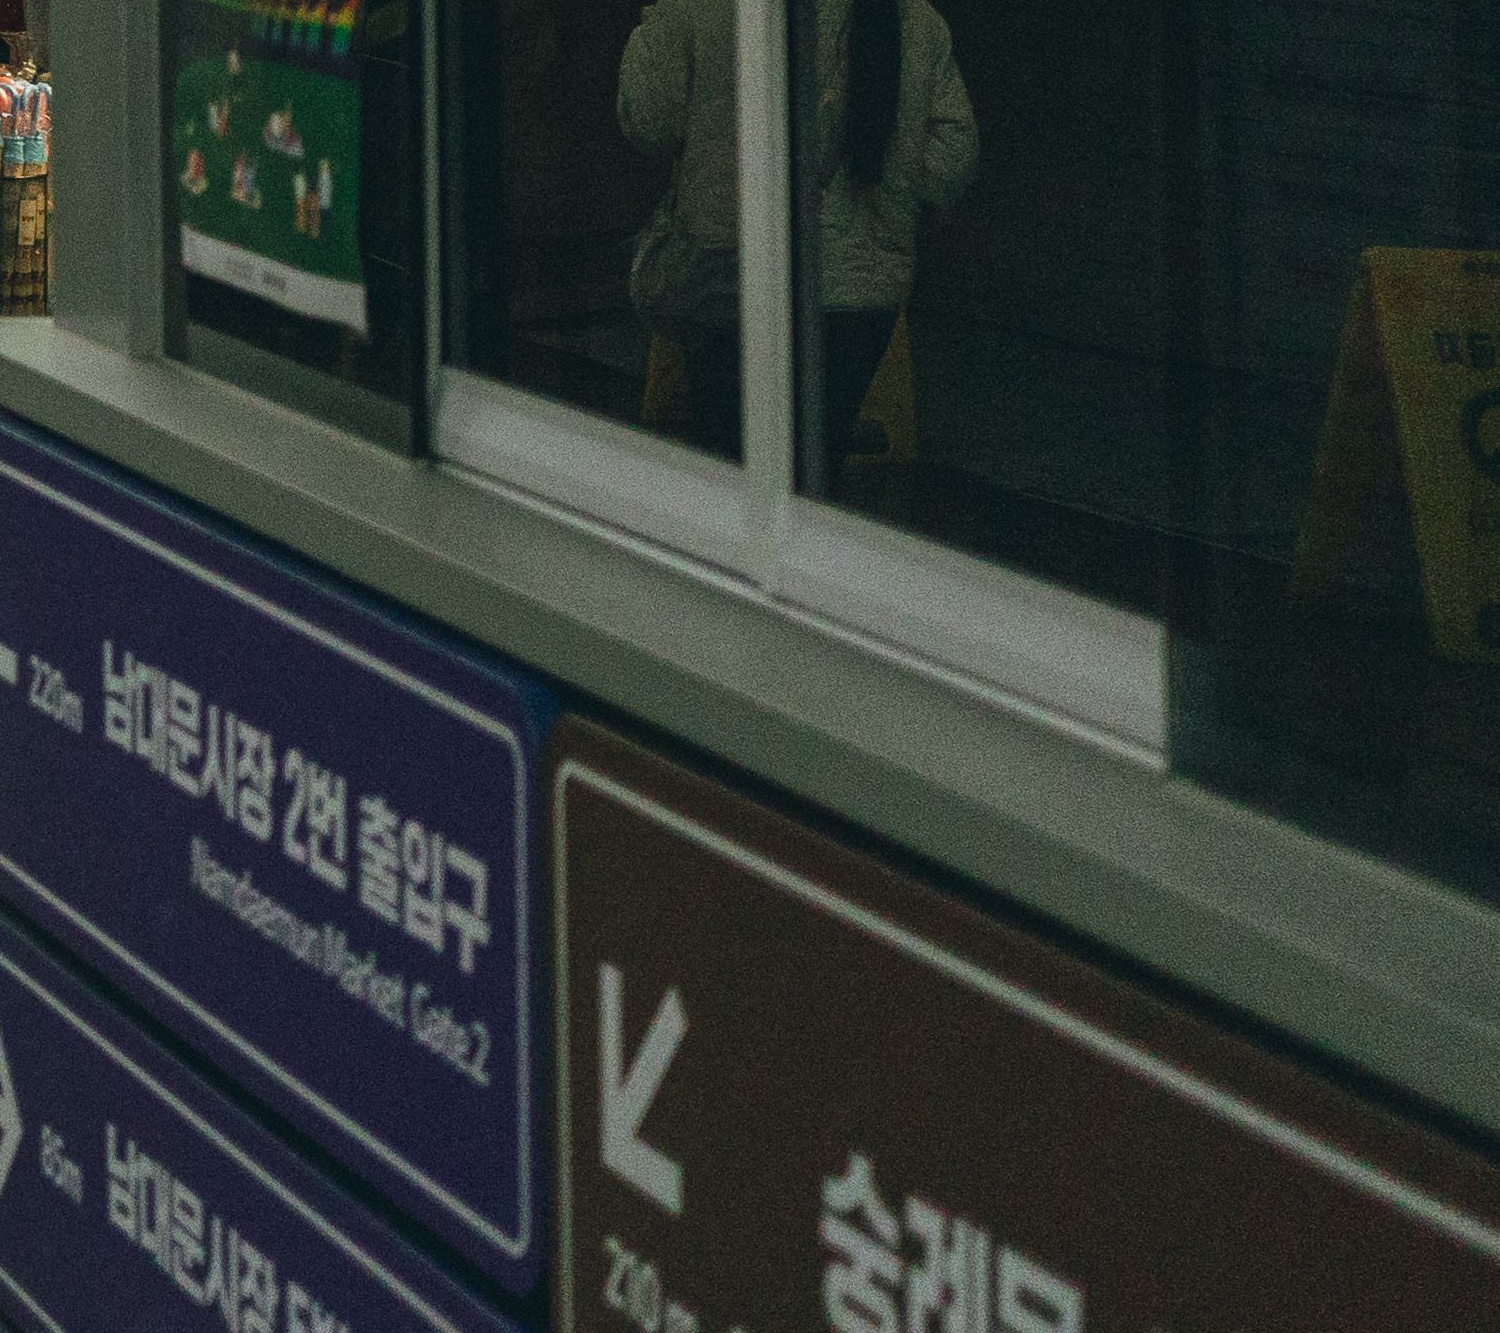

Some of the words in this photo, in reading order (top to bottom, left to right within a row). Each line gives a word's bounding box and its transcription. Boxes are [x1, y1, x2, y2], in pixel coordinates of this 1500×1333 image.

[101, 637, 277, 842] 남대문시장
[281, 747, 349, 893] 2번
[357, 793, 492, 975] 출입구
[105, 1120, 279, 1333] 남대문시장
